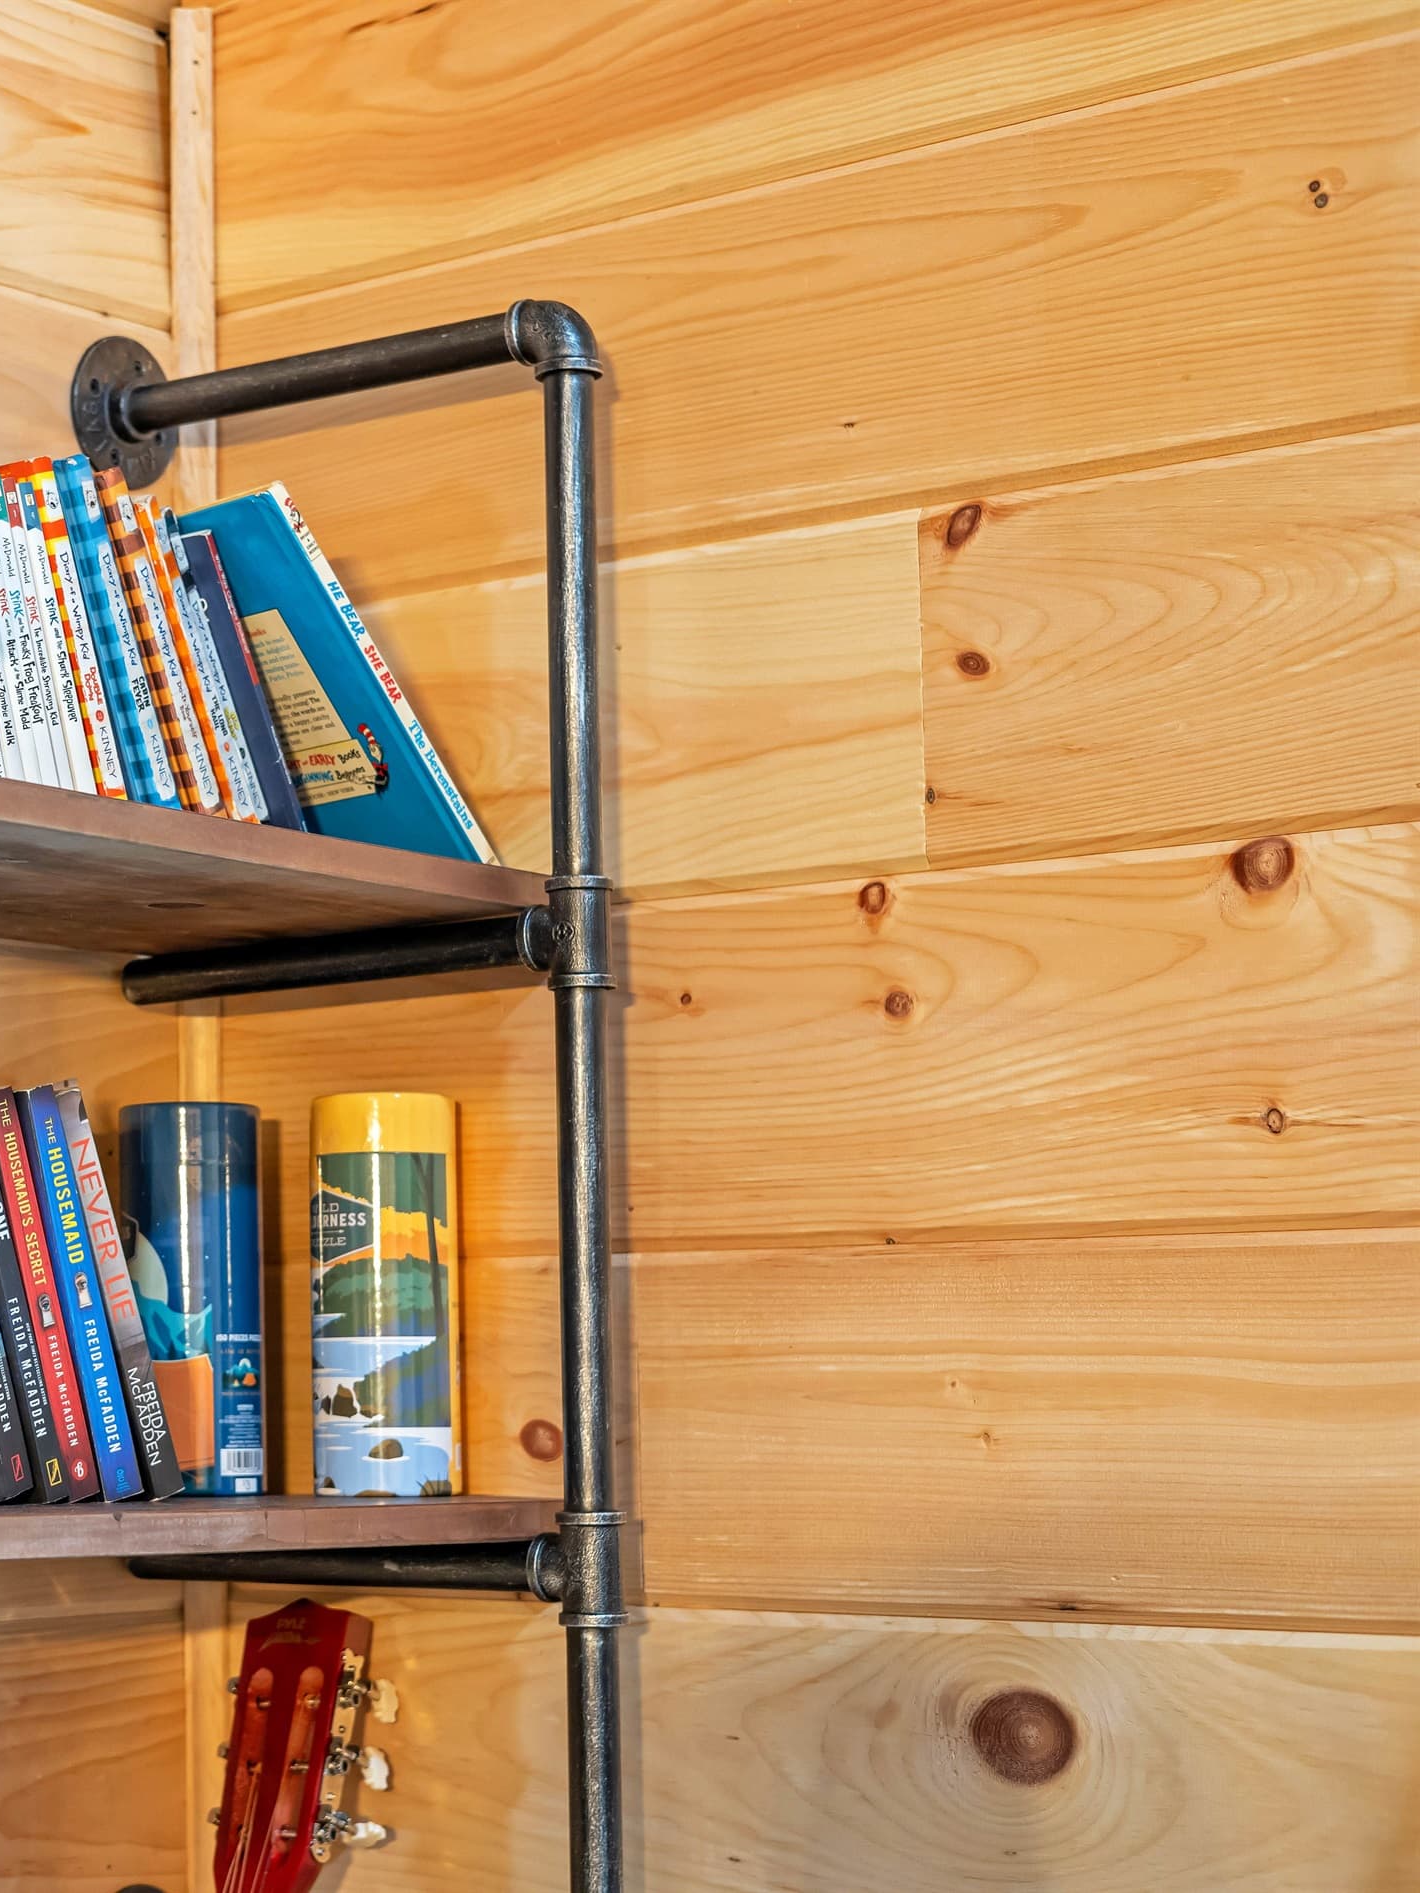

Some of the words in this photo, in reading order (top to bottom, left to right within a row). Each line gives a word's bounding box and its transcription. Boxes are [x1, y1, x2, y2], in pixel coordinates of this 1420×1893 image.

[2, 537, 16, 578] McDonald
[18, 544, 32, 584] McDonald
[37, 545, 50, 584] McDonald
[8, 590, 24, 619] Stink
[44, 597, 60, 626] Stink
[60, 552, 74, 584] Diary
[72, 604, 84, 641] Wimpy
[80, 642, 90, 660] Kid
[102, 553, 116, 587] Diary
[118, 608, 132, 646] Wimpy
[128, 648, 138, 666] Kid
[140, 566, 154, 599] Diary
[158, 620, 171, 657] Wimpy
[168, 659, 178, 677] Kid
[19, 634, 32, 660] Freaky
[25, 596, 40, 624] Stink
[36, 638, 46, 674] Incredible
[42, 675, 54, 711] Shrinking
[48, 712, 60, 726] Kid
[57, 650, 70, 678] Shark
[176, 588, 189, 618] Diary
[191, 640, 205, 676] Wimpy
[202, 674, 212, 693] Kid
[328, 580, 343, 602] HE
[340, 603, 365, 642] BEAR,
[364, 645, 385, 673] SHE
[379, 671, 402, 704] BEAR
[6, 639, 18, 666] Attack
[15, 681, 24, 705] Slime
[20, 708, 30, 730] Mold
[23, 661, 36, 684] Frog
[84, 673, 94, 702] DOWN
[90, 666, 104, 705] DOUBLE
[132, 678, 146, 713] FEVER
[138, 676, 151, 708] CABIN
[28, 685, 44, 724] Freakout
[62, 680, 78, 723] Sleepover
[210, 708, 220, 732] HAUL
[212, 696, 220, 710] THE
[218, 711, 228, 737] LONG
[4, 720, 16, 746] Walk
[100, 726, 118, 778] KINNEY
[151, 734, 170, 789] KINNEY
[194, 743, 214, 797] KINNEY
[228, 756, 248, 807] KINNEY
[244, 762, 262, 810] KINNEY
[407, 718, 427, 751] The
[424, 749, 475, 832] Berenstains
[44, 1116, 57, 1144] THE
[4, 1130, 34, 1228] HOUSEMAID'S
[24, 1231, 48, 1286] SECRET
[48, 1146, 86, 1266] HOUSEMAID
[70, 1136, 120, 1266] NEVER
[104, 1273, 138, 1323] LIE
[7, 1297, 29, 1352] FREIDA
[20, 1359, 48, 1439] McFADDEN
[48, 1334, 64, 1379] FREIDA
[57, 1383, 80, 1447] McFADDEN
[84, 1319, 104, 1372] FREIDA
[95, 1376, 122, 1454] McFADDEN
[128, 1367, 162, 1466] McFADDEN
[142, 1381, 167, 1442] FREIDA
